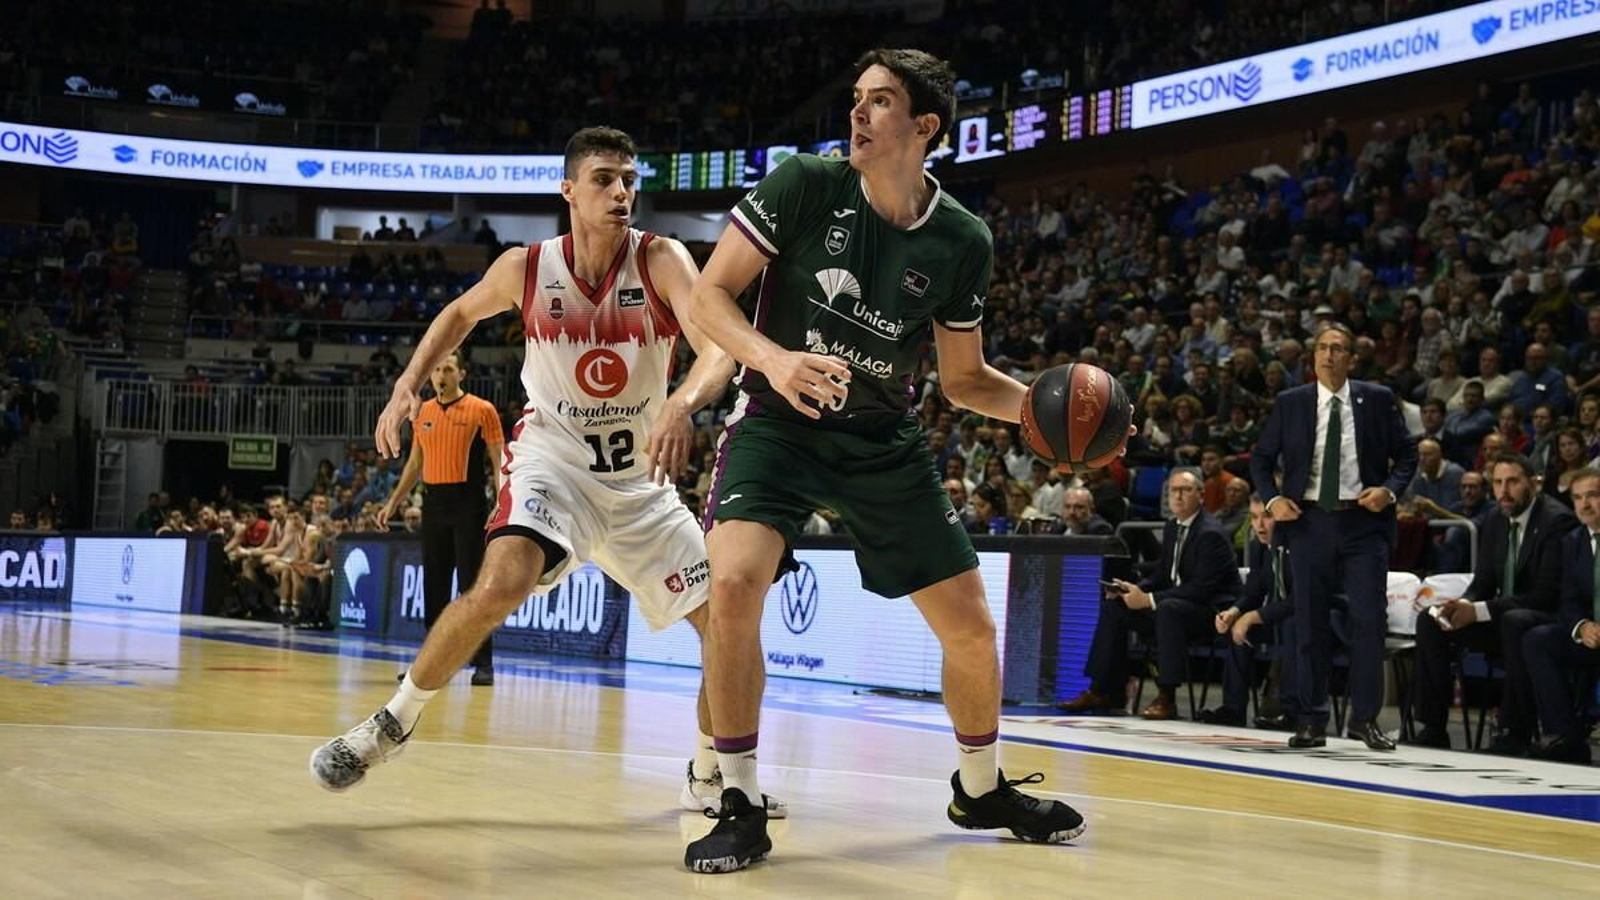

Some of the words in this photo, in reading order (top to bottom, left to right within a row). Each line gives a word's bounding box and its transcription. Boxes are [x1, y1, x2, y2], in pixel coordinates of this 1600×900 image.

[1509, 0, 1600, 31] EMPRES
[1325, 27, 1440, 74] FORMACIÓN
[150, 149, 267, 172] FORMACIÓN
[330, 160, 415, 179] EMPRESA
[421, 164, 497, 181] TRABAJO
[583, 428, 635, 473] 12
